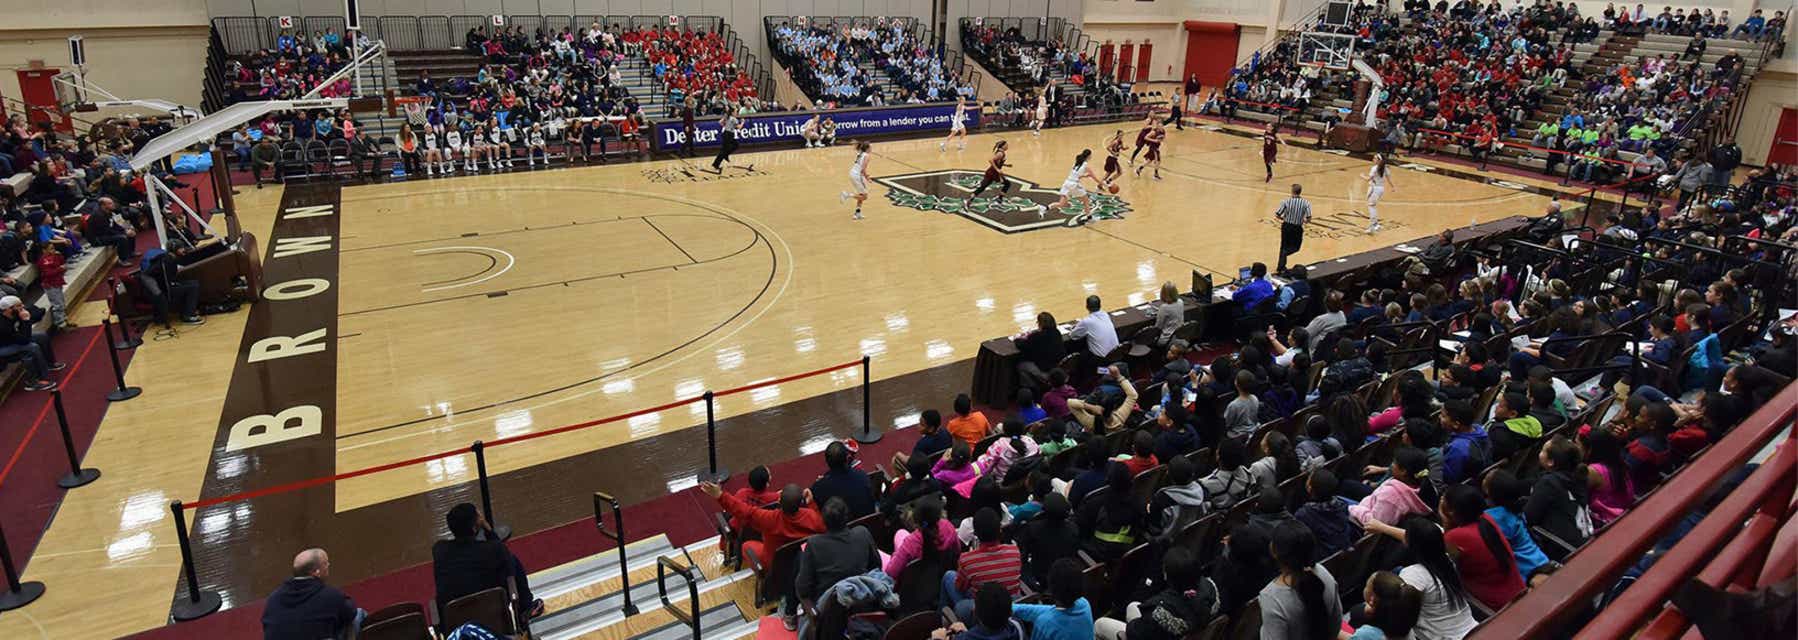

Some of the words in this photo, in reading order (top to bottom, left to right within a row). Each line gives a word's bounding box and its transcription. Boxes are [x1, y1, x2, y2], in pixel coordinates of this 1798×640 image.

[280, 17, 291, 27] K
[494, 16, 502, 24] L
[834, 121, 858, 130] orrow
[860, 119, 881, 128] from
[882, 119, 888, 127] a
[889, 117, 916, 126] lender
[918, 116, 933, 127] you
[934, 115, 949, 123] can
[664, 126, 718, 144] Deter
[722, 122, 771, 140] redit
[774, 121, 804, 136] Uni
[226, 204, 334, 452] BROWN
